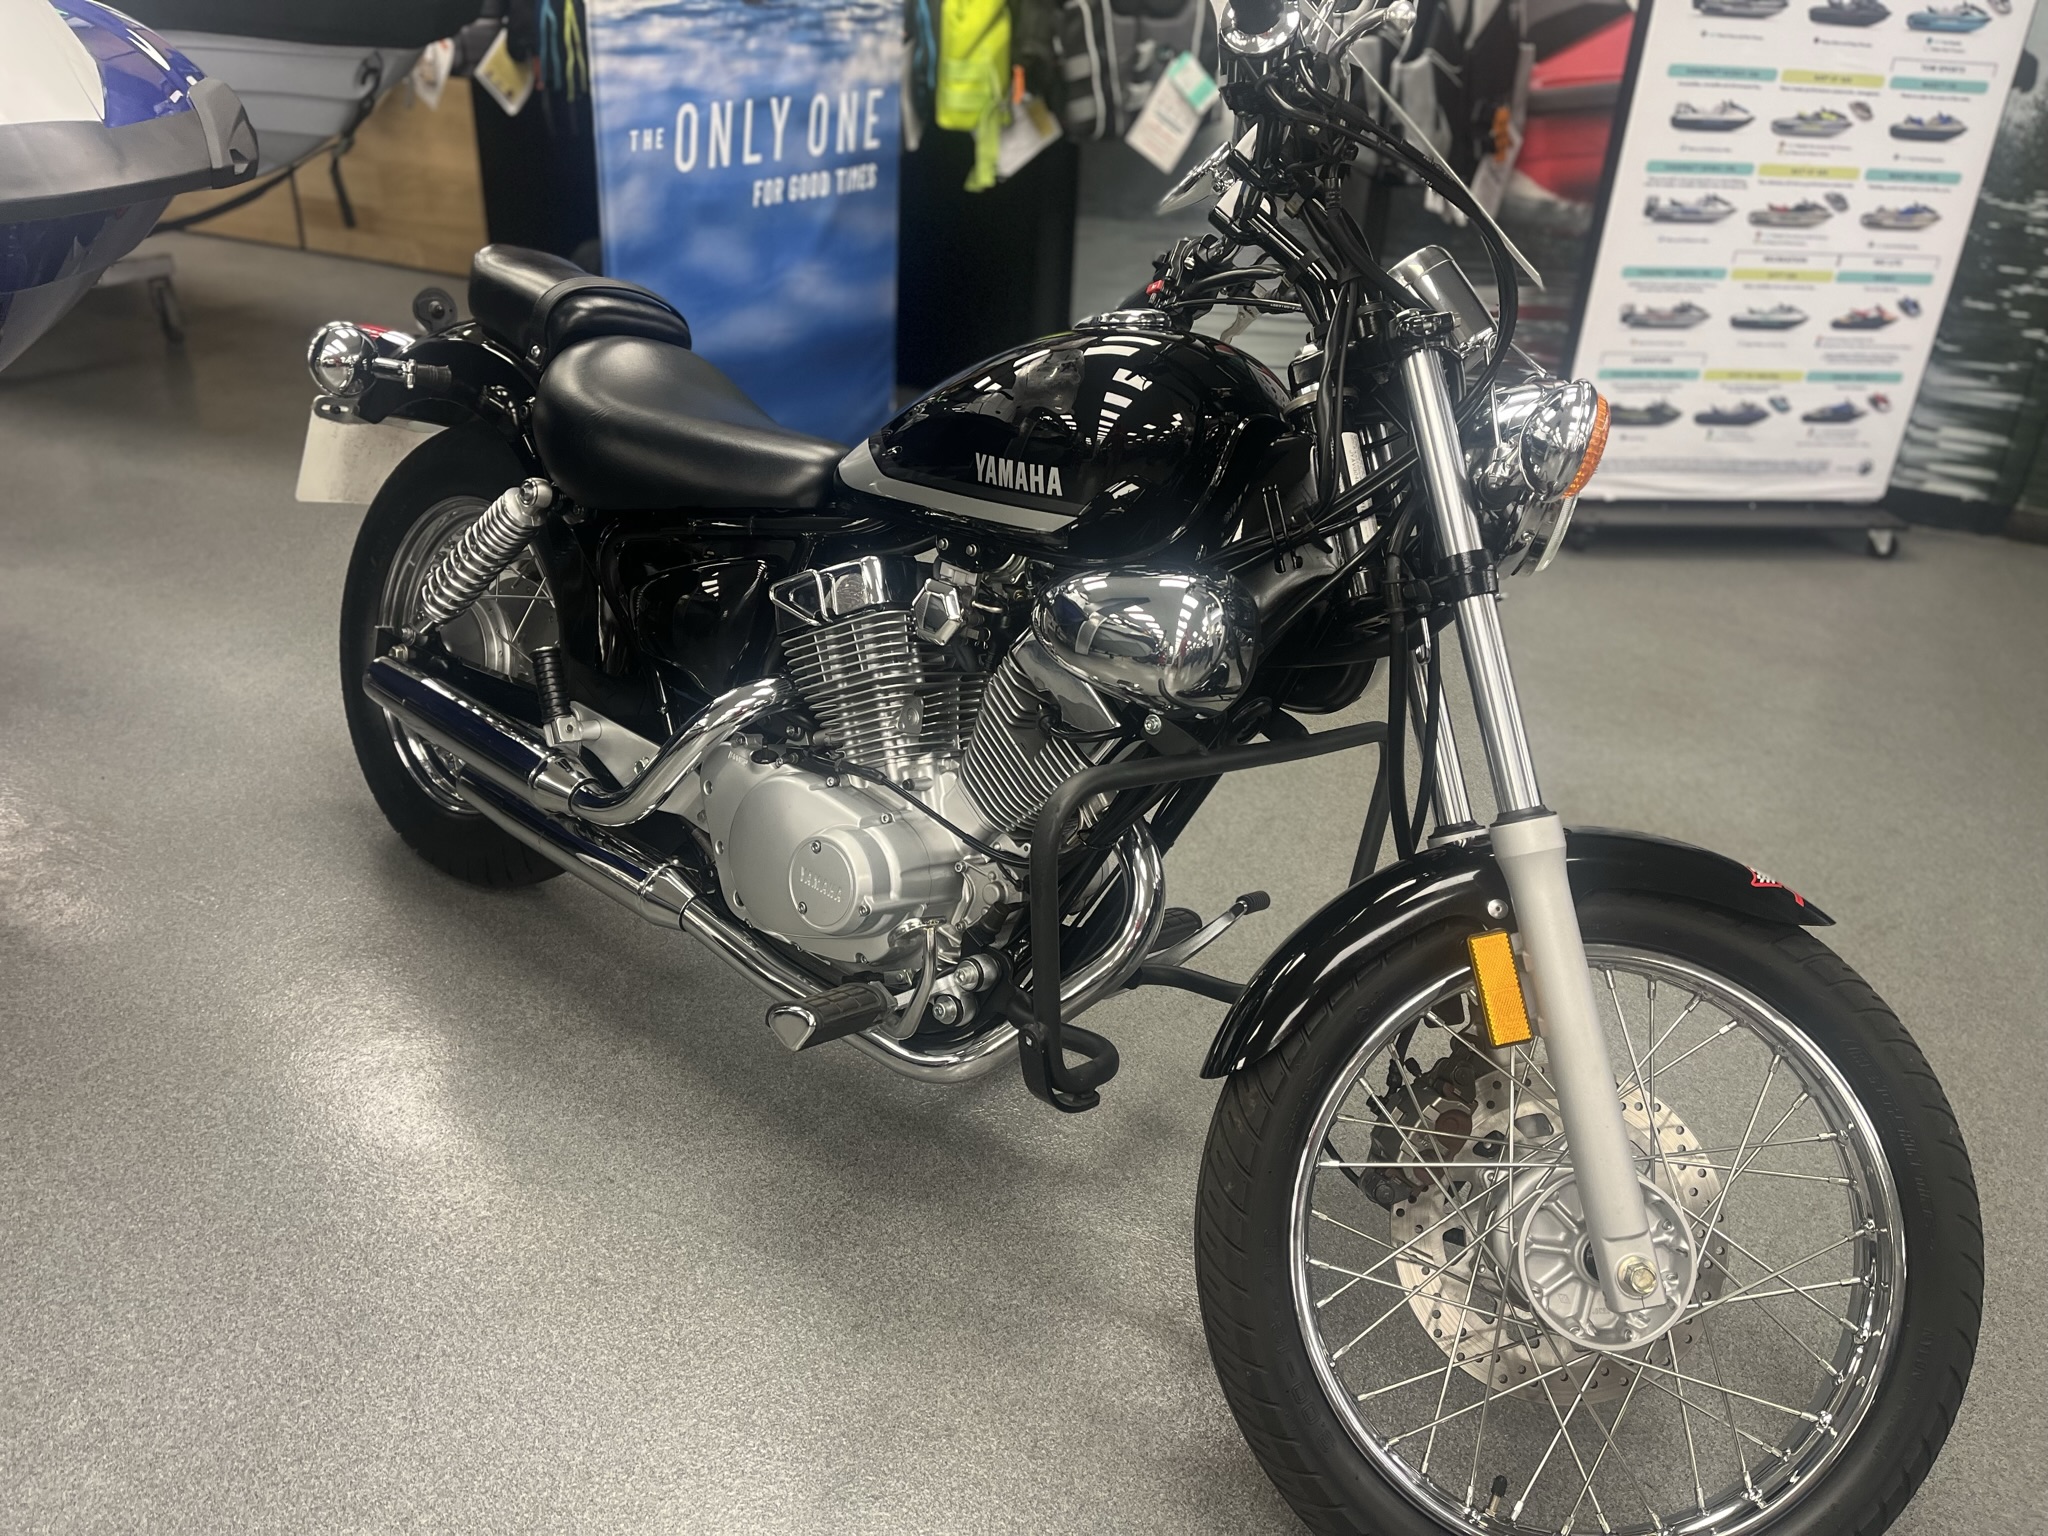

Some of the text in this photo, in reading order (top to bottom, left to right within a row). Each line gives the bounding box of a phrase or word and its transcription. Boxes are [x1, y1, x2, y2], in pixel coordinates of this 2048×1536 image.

[629, 88, 884, 173] THE ONLY ONE
[751, 162, 878, 208] FOR GOOD TIMES
[975, 451, 1063, 497] YAMAHA
[799, 865, 842, 903] YAMAHA
